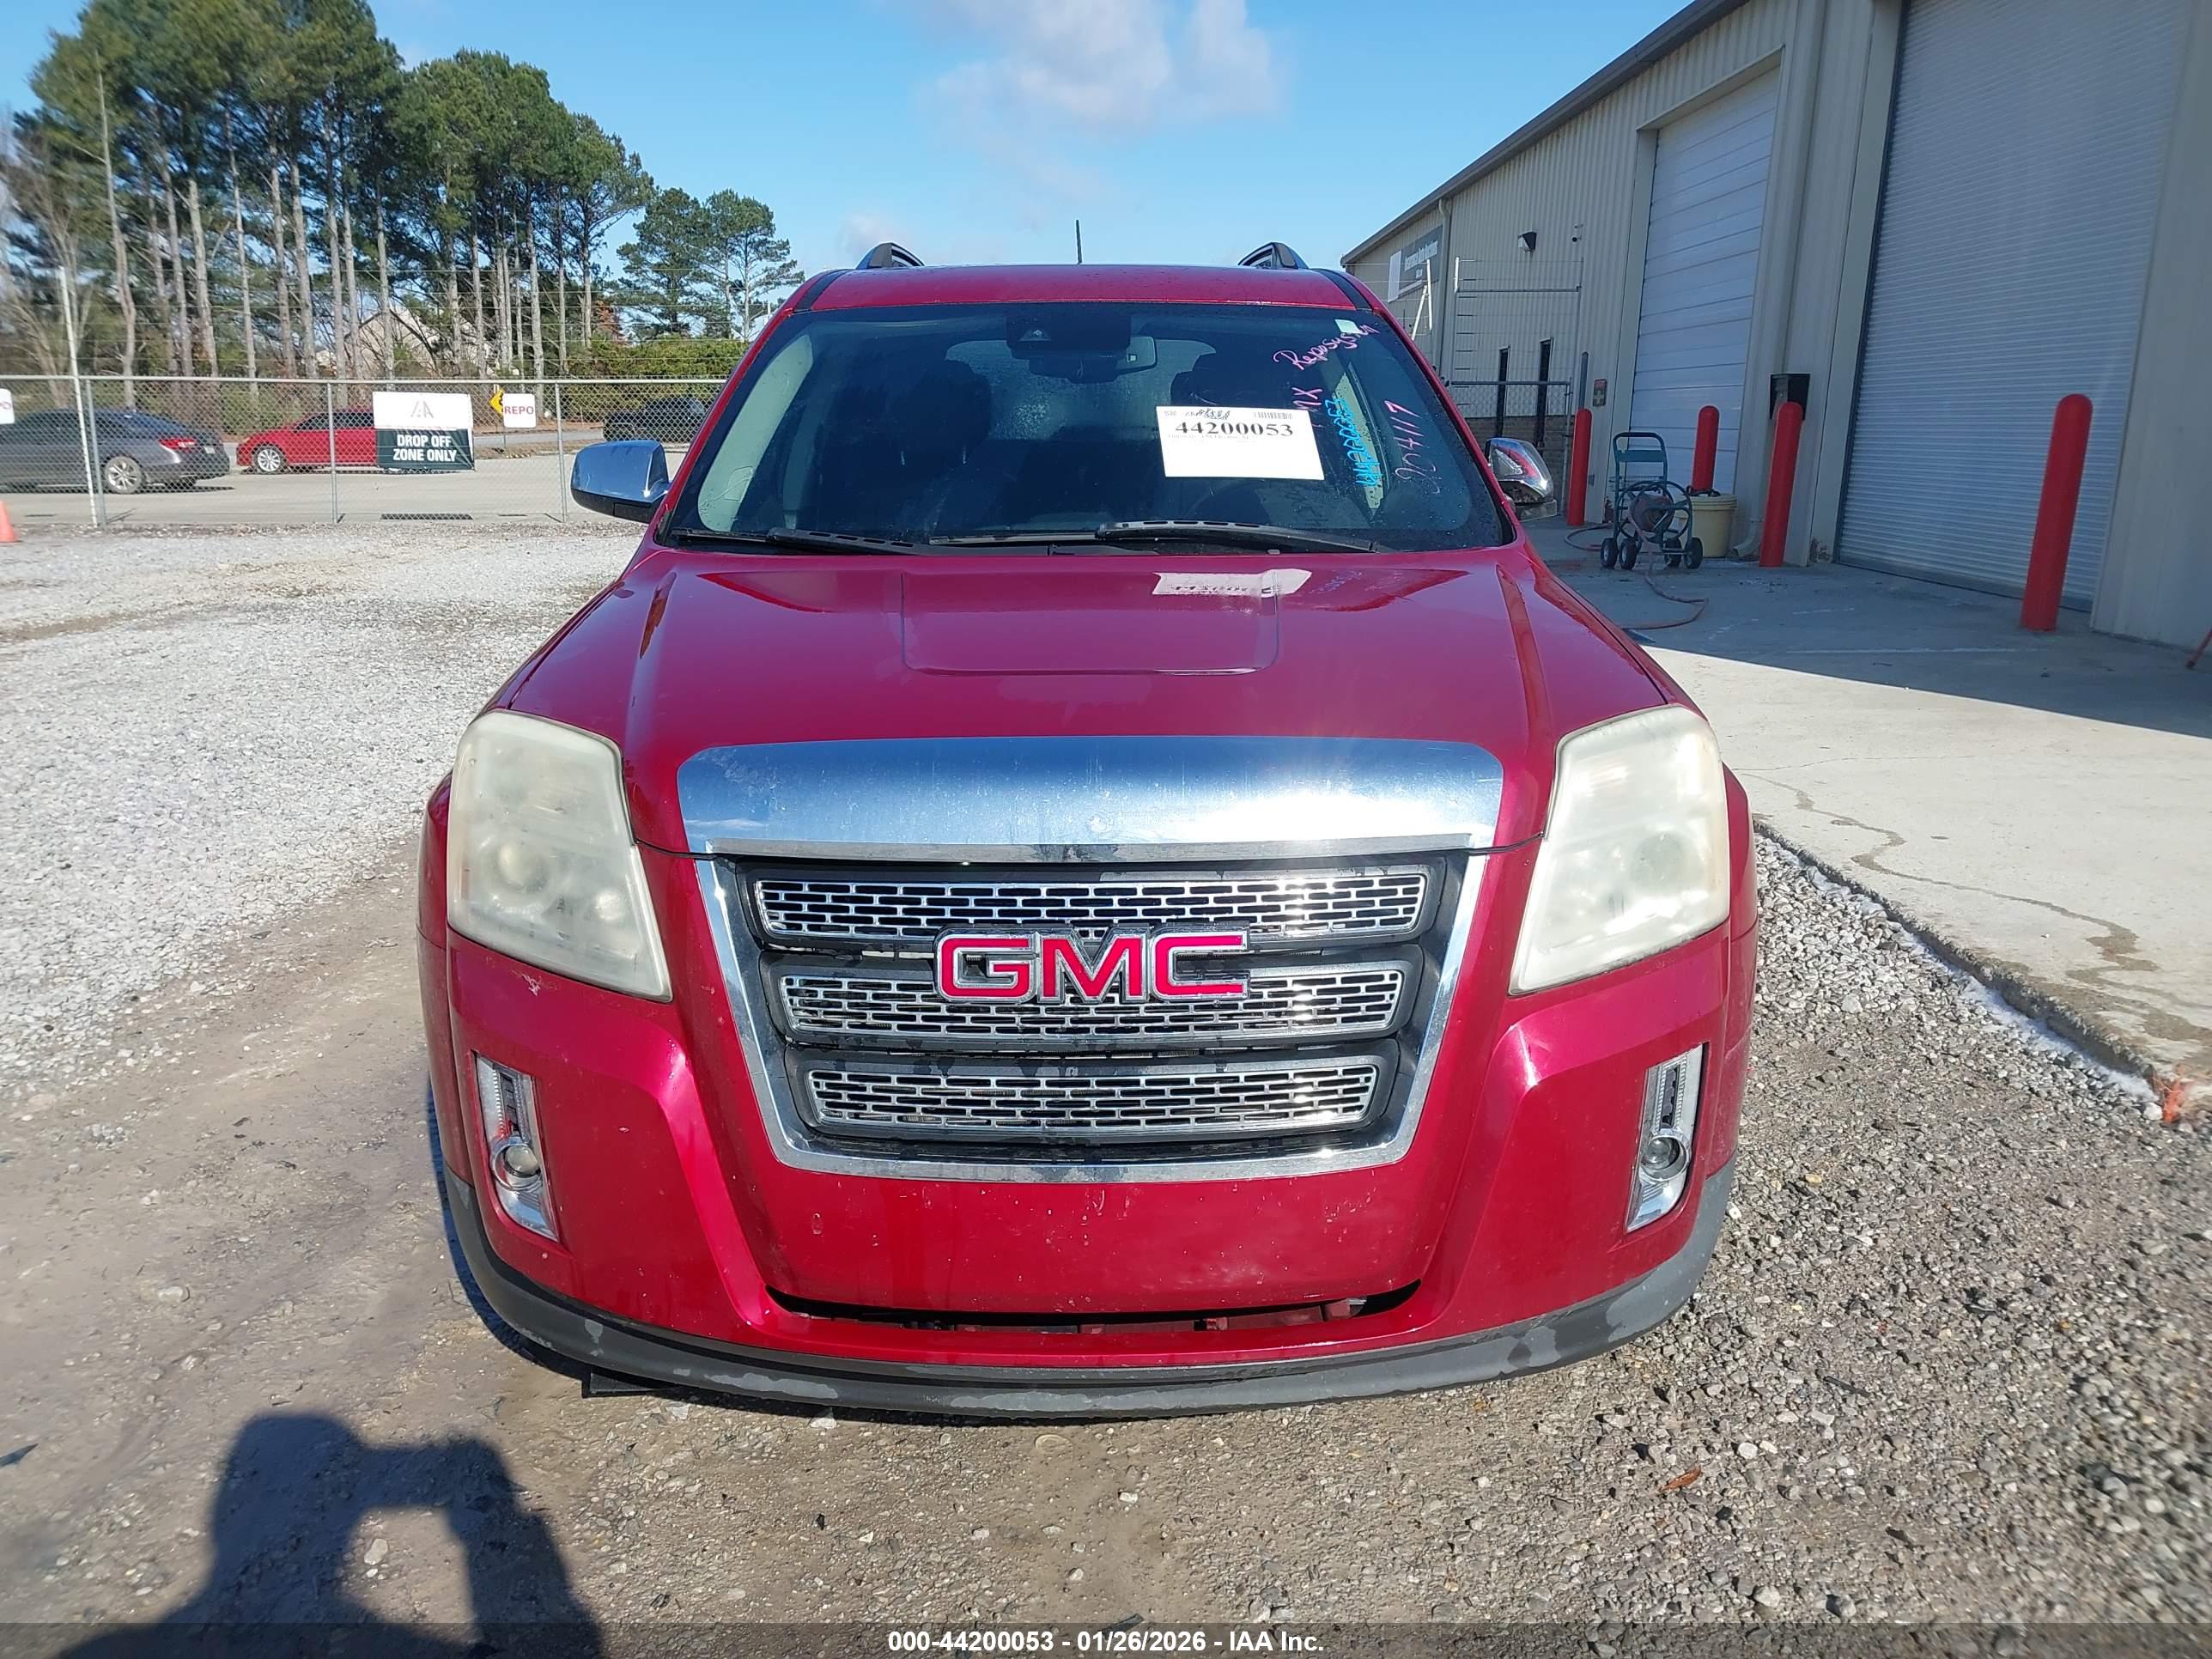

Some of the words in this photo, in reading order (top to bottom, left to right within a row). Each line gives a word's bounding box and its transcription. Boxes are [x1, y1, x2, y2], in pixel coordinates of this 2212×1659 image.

[504, 405, 534, 415] REPO
[1175, 421, 1294, 437] 44200053
[397, 435, 428, 447] DROP
[433, 434, 453, 447] OFF
[392, 448, 425, 461] ZONE
[428, 448, 457, 462] ONLY
[934, 930, 1249, 1003] GMC
